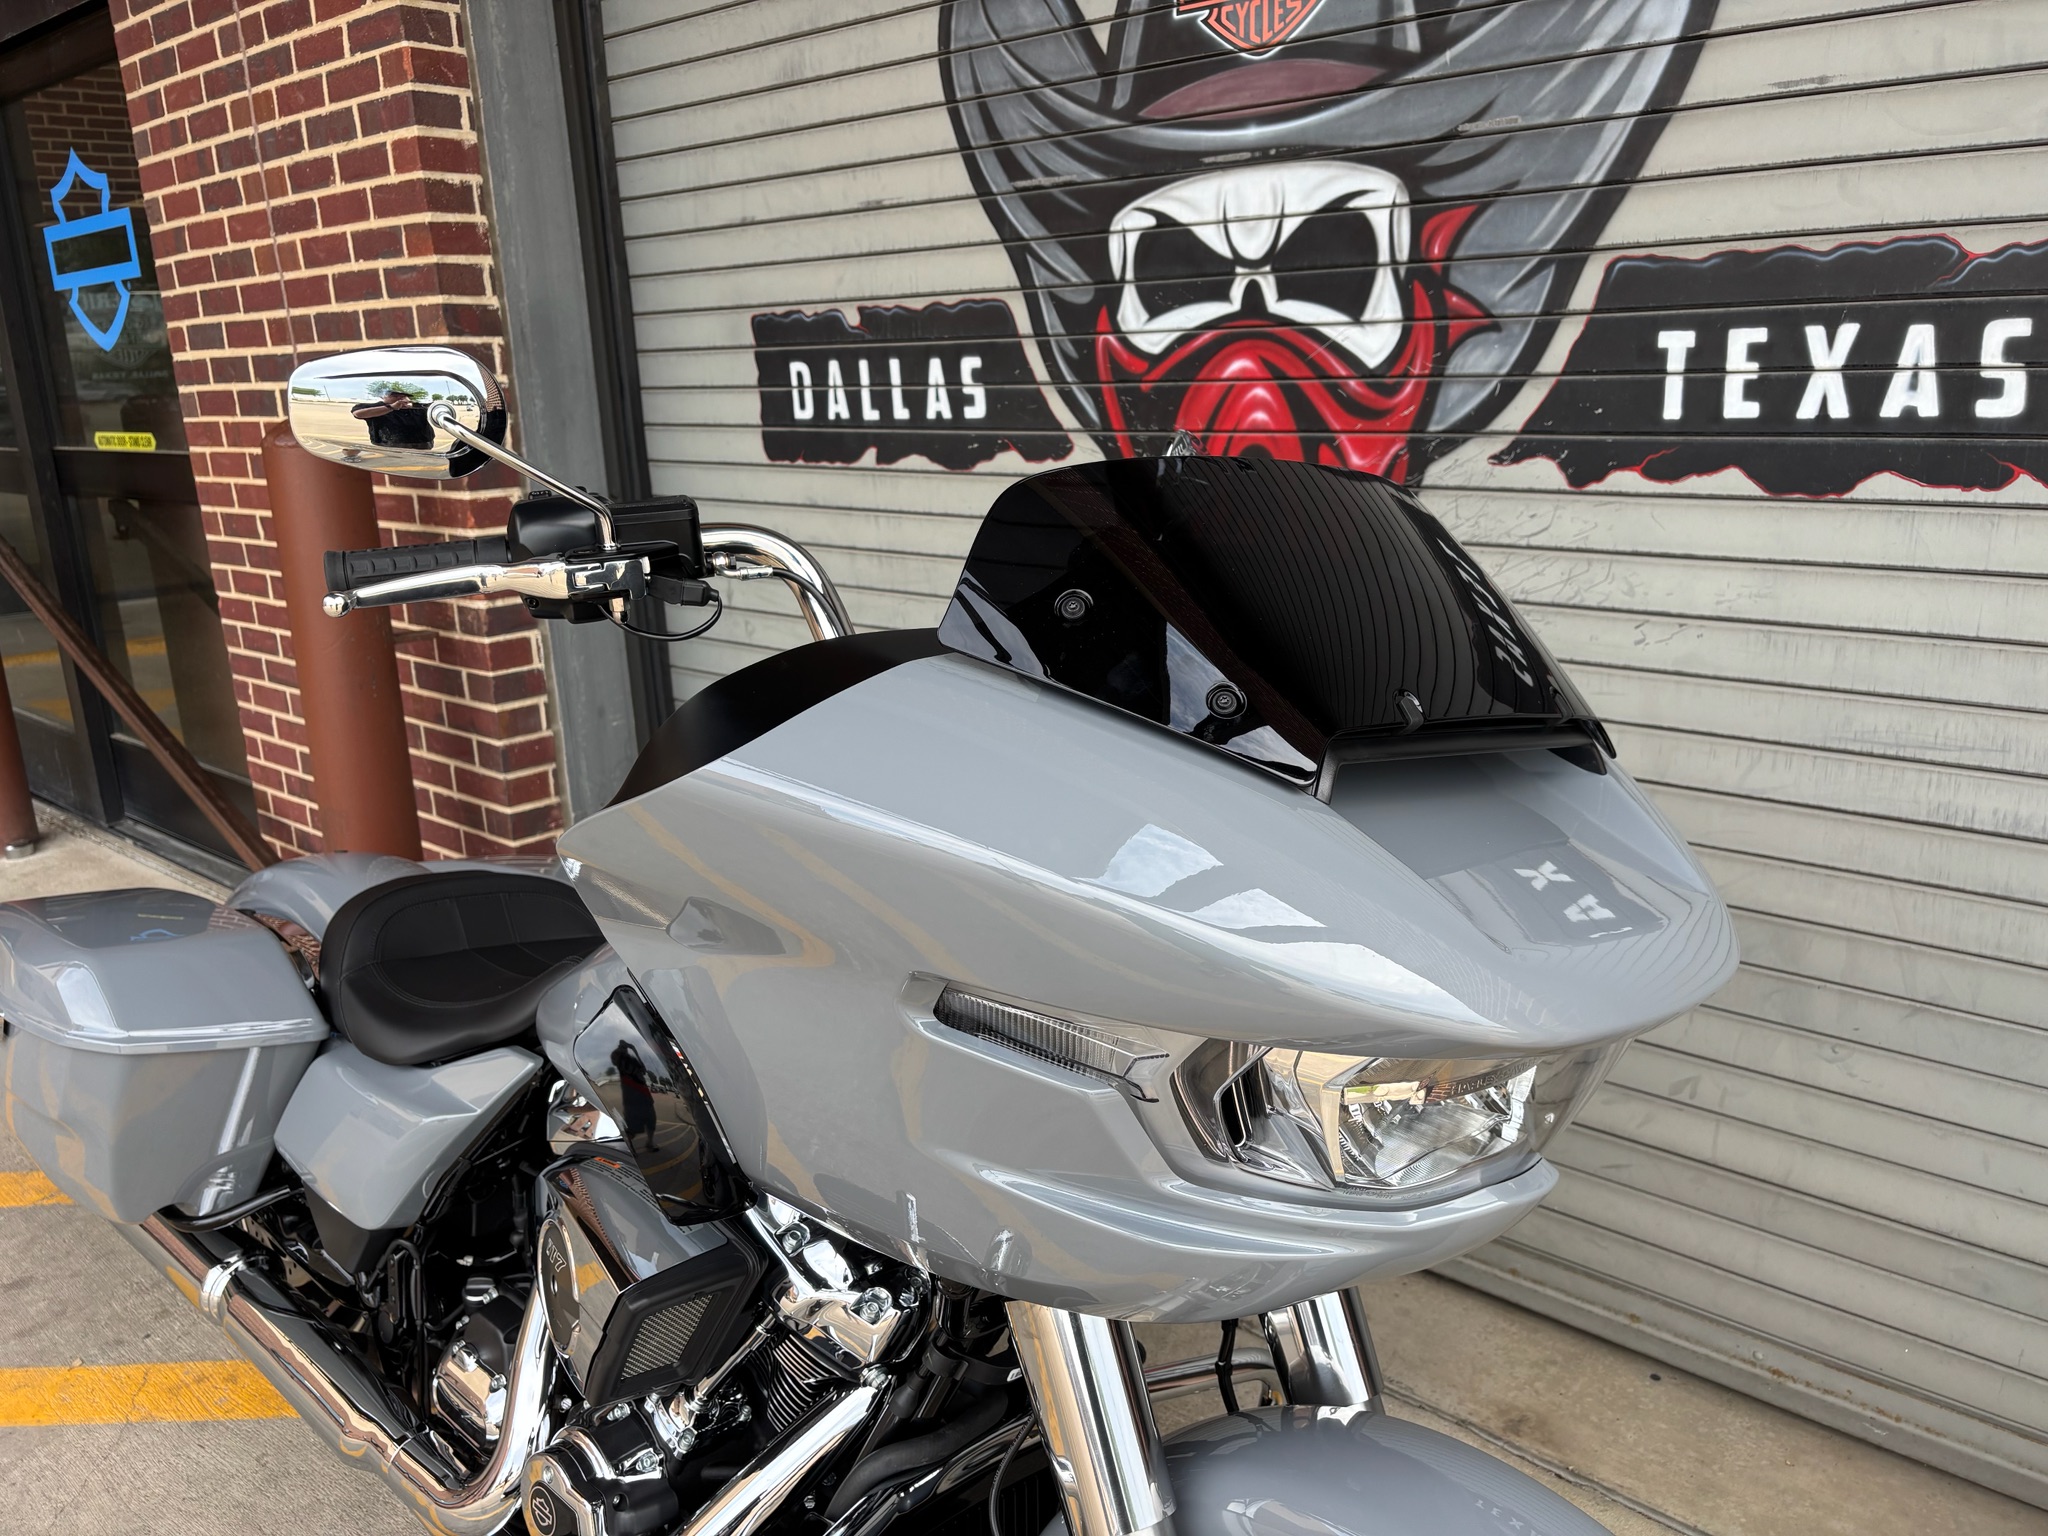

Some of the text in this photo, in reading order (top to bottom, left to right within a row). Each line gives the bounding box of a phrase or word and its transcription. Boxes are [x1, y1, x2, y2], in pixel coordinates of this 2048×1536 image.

[1220, 0, 1299, 44] CYCLES
[789, 356, 987, 421] DALLAS
[1657, 318, 2033, 420] TEXAS
